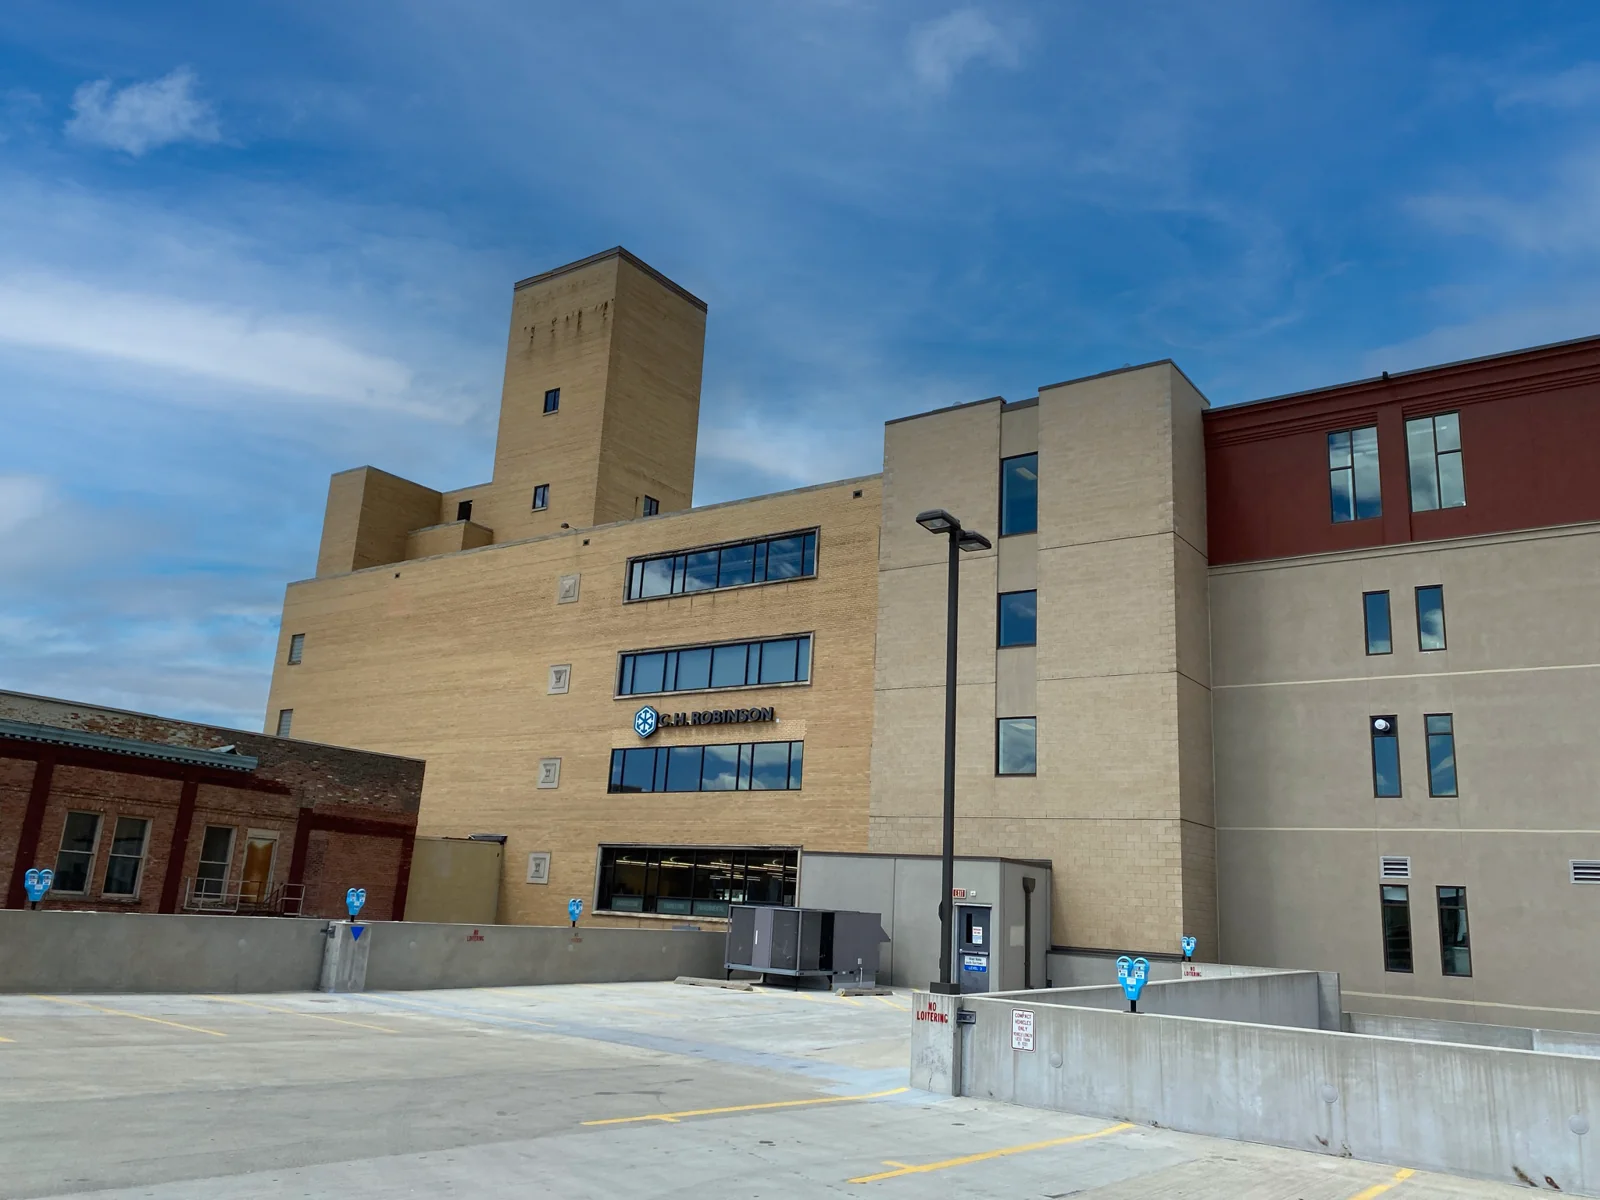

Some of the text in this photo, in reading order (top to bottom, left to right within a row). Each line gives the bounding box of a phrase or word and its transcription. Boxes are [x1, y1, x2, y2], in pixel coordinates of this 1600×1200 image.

[690, 707, 774, 726] ROBINSON
[928, 1001, 937, 1011] NO
[916, 1010, 949, 1024] LOITERING
